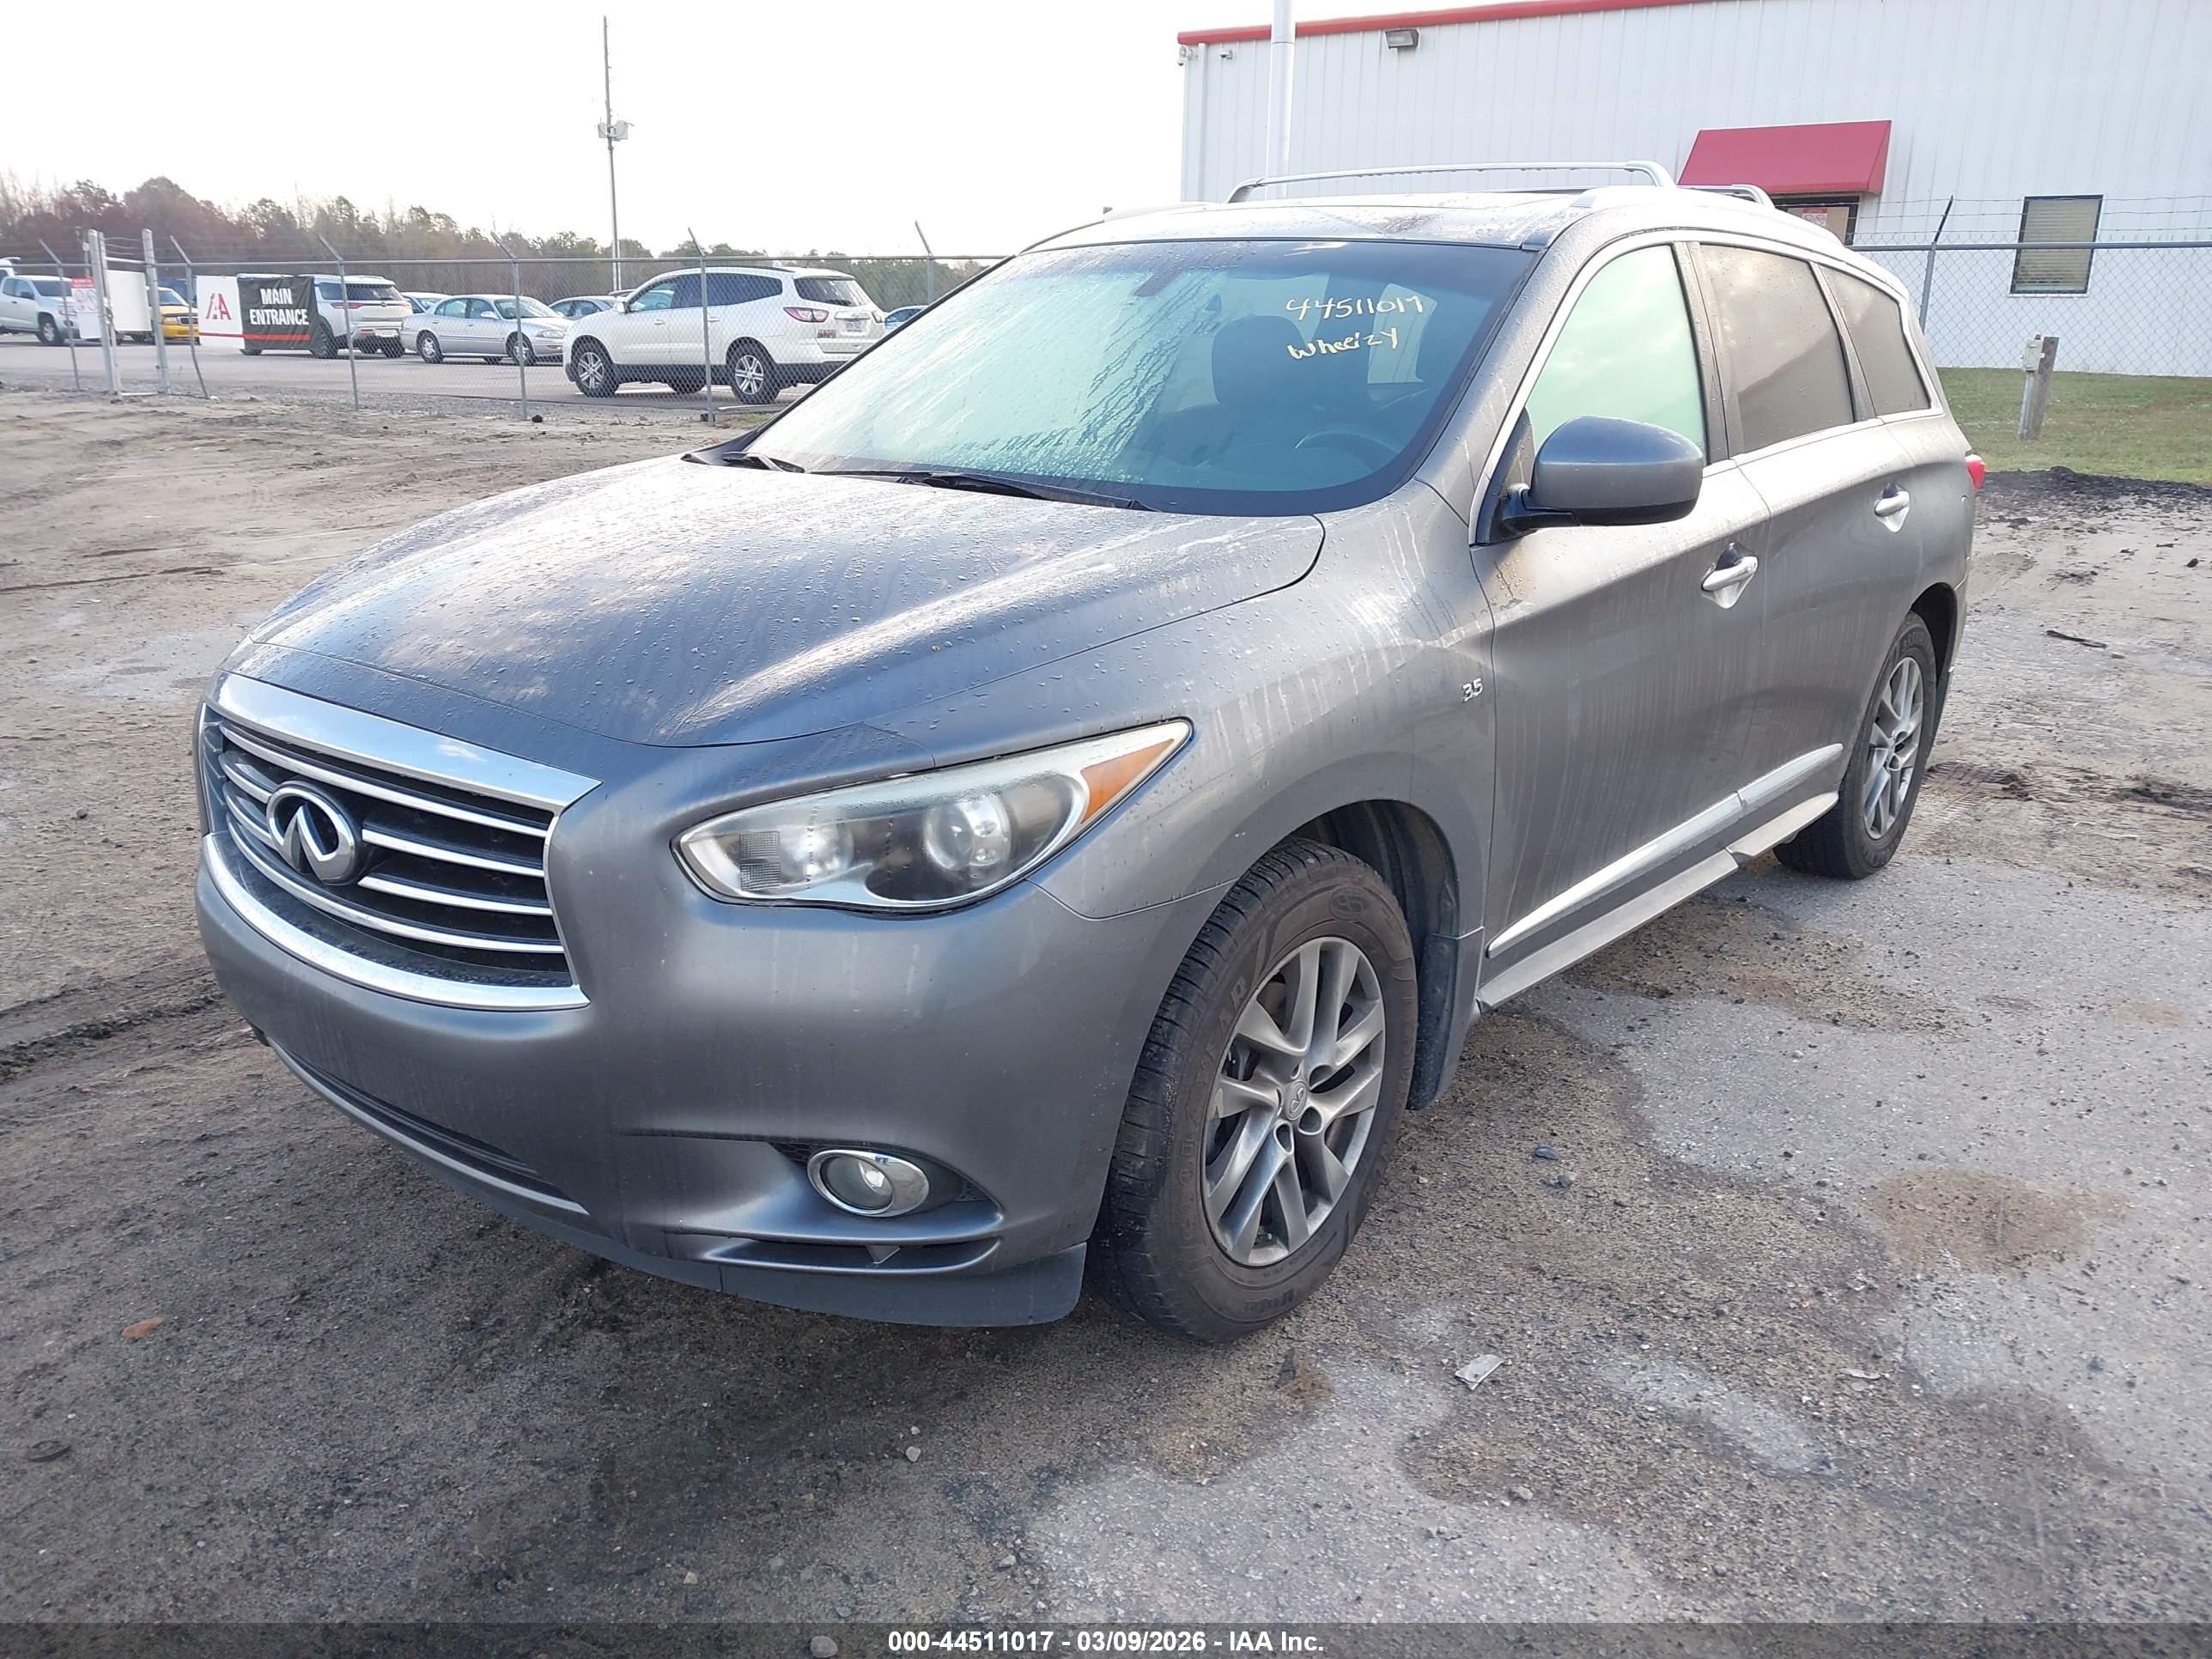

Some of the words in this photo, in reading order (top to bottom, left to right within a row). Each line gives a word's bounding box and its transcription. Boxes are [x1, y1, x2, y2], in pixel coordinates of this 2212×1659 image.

[260, 288, 293, 305] MAIN
[249, 308, 309, 325] ENTRANCE
[1285, 295, 1424, 321] 44511017
